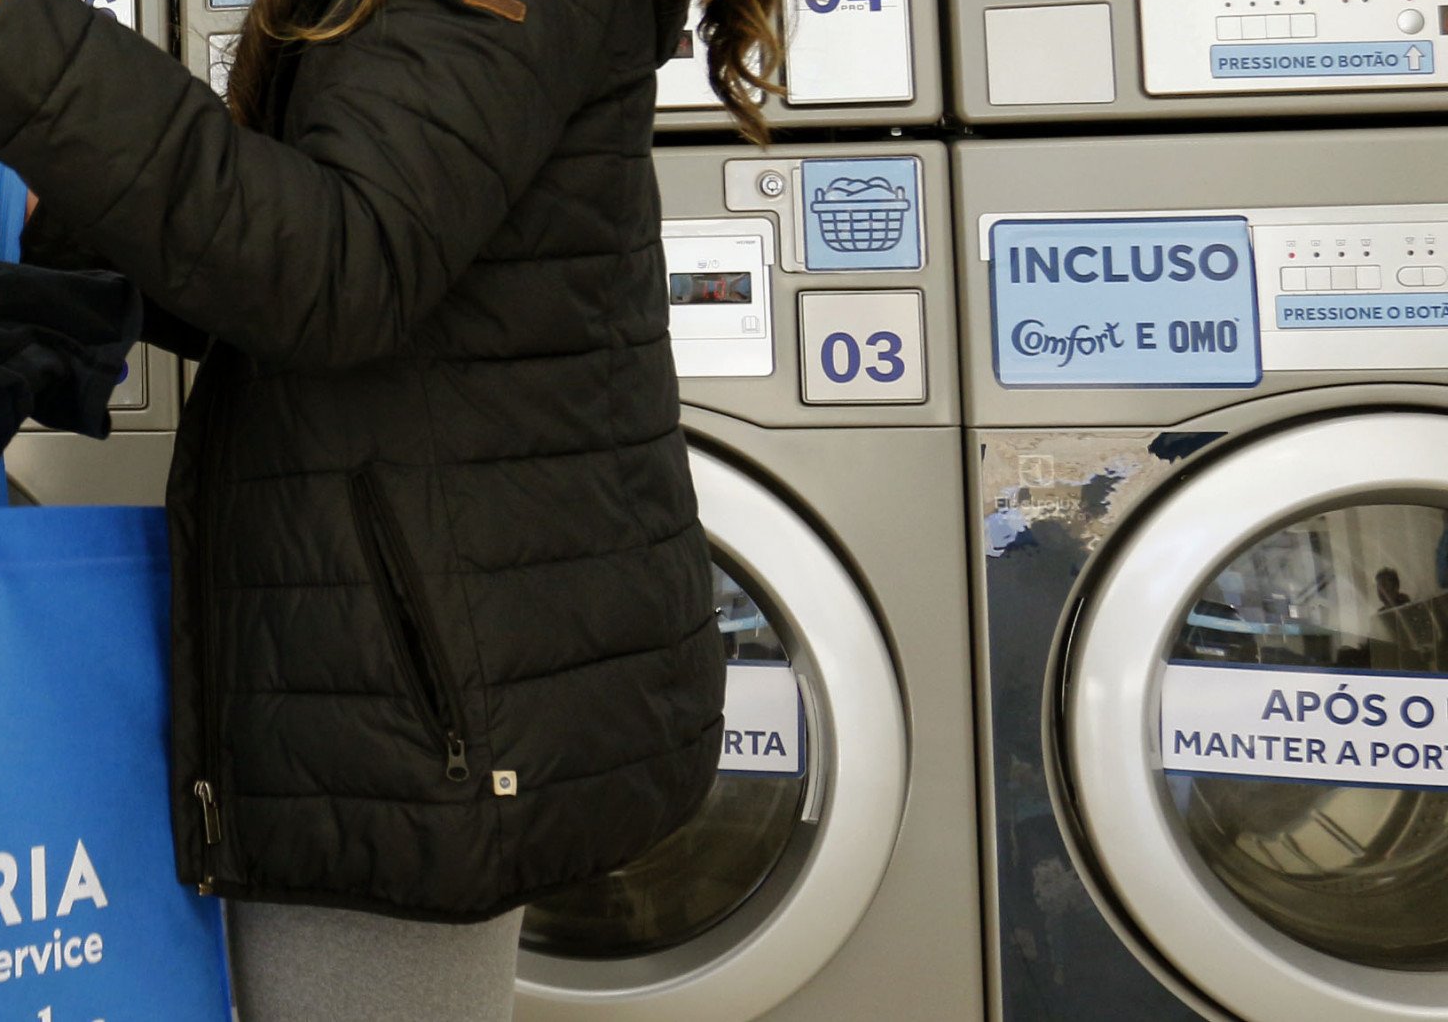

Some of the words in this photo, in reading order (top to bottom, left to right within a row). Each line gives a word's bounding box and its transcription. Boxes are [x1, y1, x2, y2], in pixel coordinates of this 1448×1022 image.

[1218, 55, 1315, 70] PRESSIONE
[1320, 55, 1334, 68] O
[1338, 51, 1399, 68] BOTÃO
[1010, 243, 1239, 284] INCLUSO
[1284, 307, 1383, 321] PRESSIONE
[1387, 306, 1400, 319] O
[819, 330, 905, 383] 03
[1011, 319, 1124, 367] Comfort
[1137, 323, 1157, 350] E
[1168, 318, 1239, 354] OMO
[1261, 683, 1388, 727] APÓS
[1399, 695, 1435, 729] O
[1173, 729, 1327, 765] MANTER
[1335, 741, 1361, 766] A
[1370, 741, 1448, 771] POR
